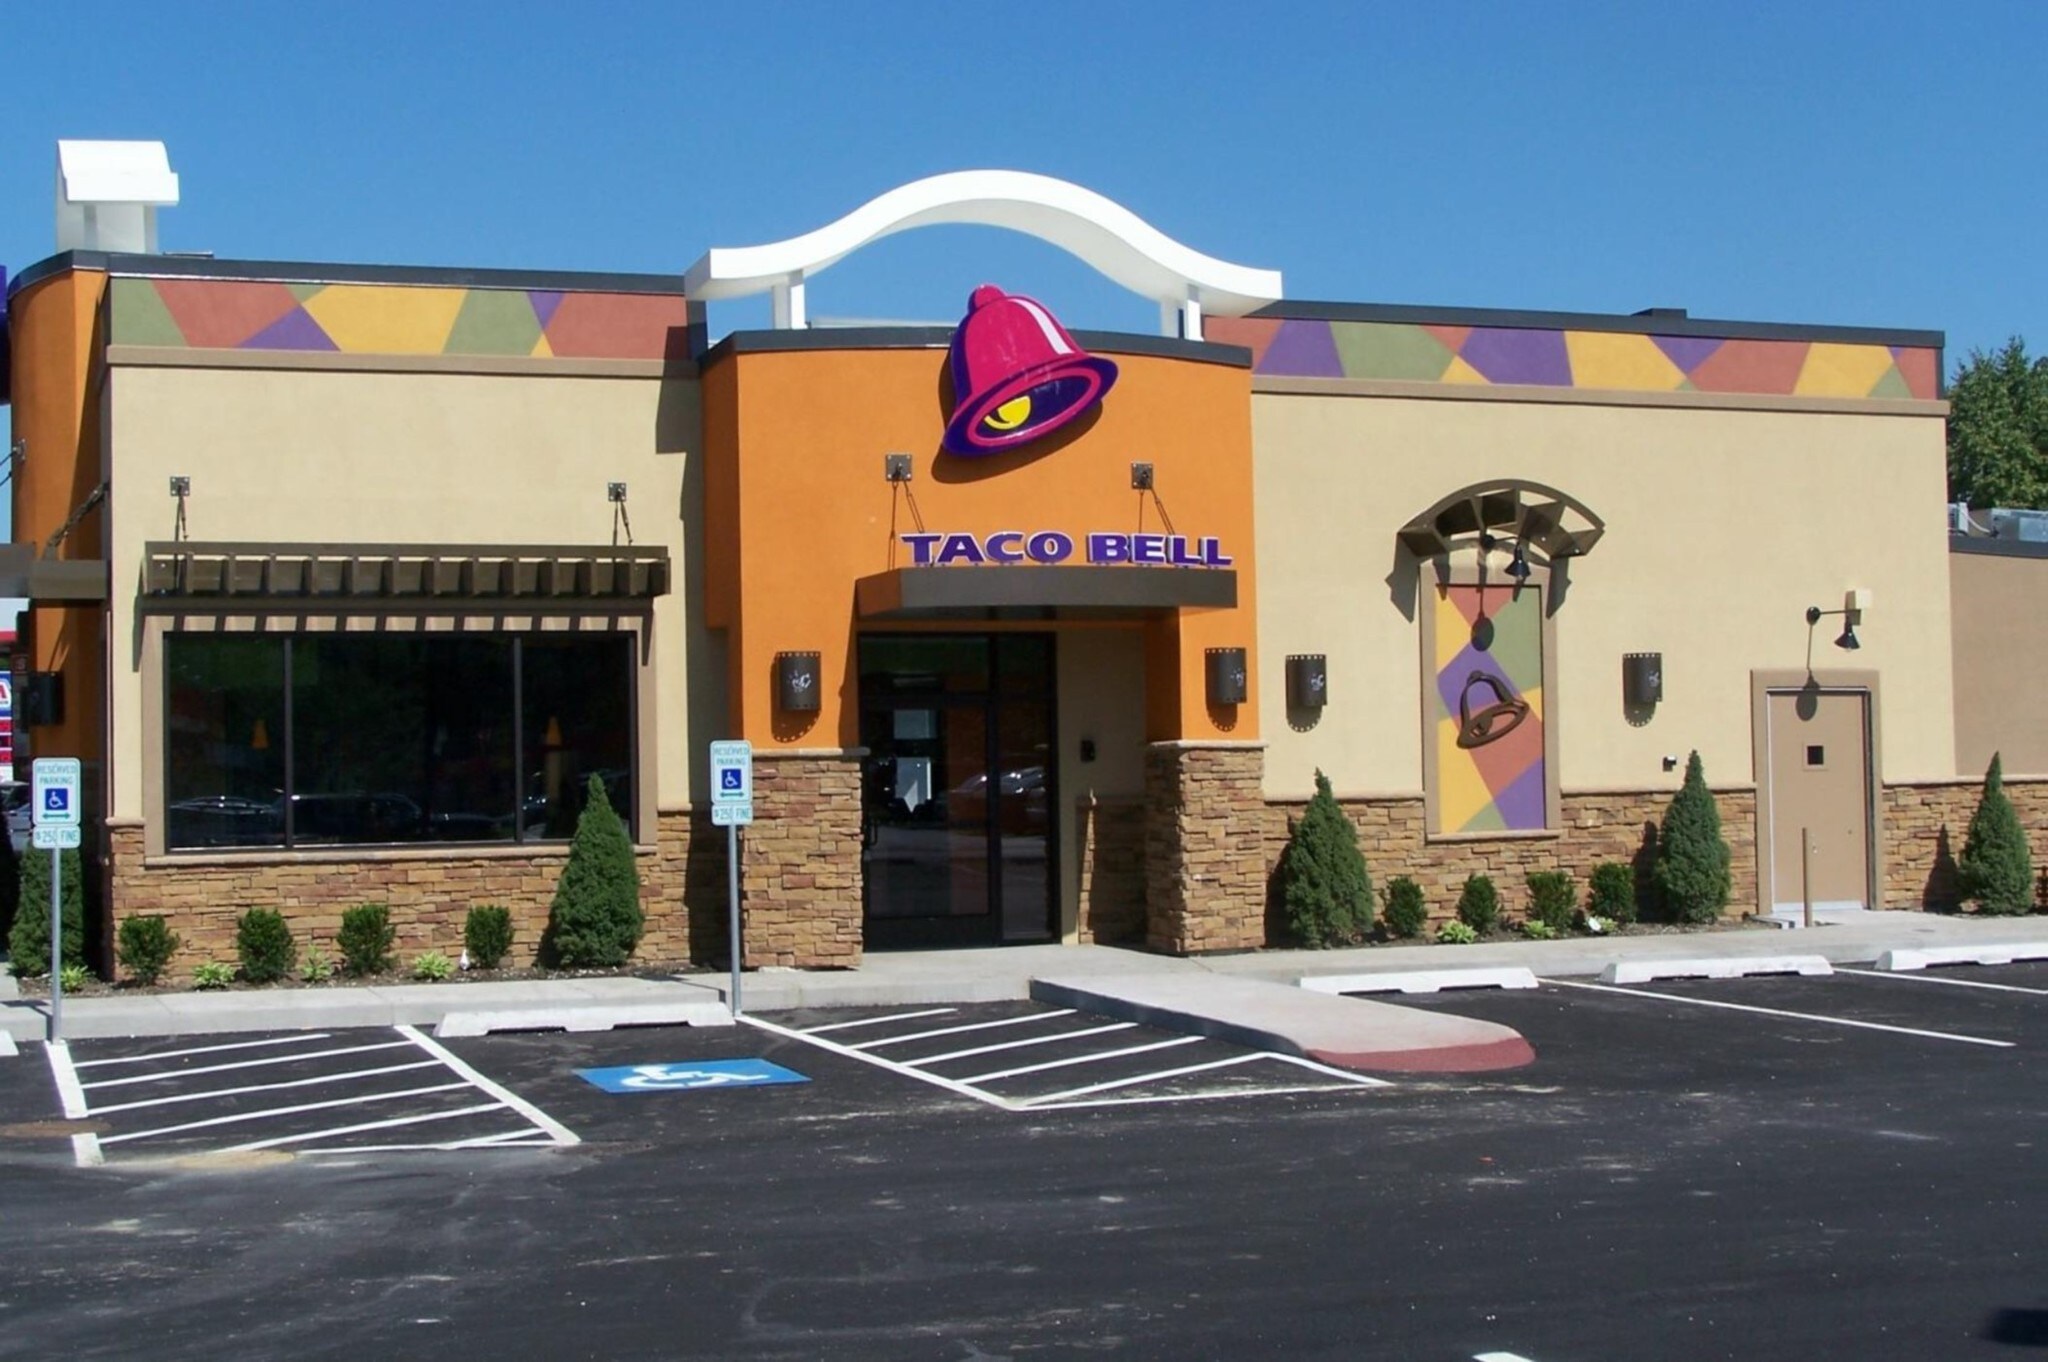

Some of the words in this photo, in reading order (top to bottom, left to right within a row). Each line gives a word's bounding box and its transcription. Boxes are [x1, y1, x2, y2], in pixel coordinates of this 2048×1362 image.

[900, 531, 1074, 565] TACO
[1086, 532, 1233, 567] BELL
[712, 746, 750, 756] RESERVED
[716, 757, 746, 766] PARKING
[36, 764, 79, 774] RESERVED
[39, 775, 74, 785] PARKING
[736, 807, 751, 819] FINE
[60, 829, 79, 843] FINE
